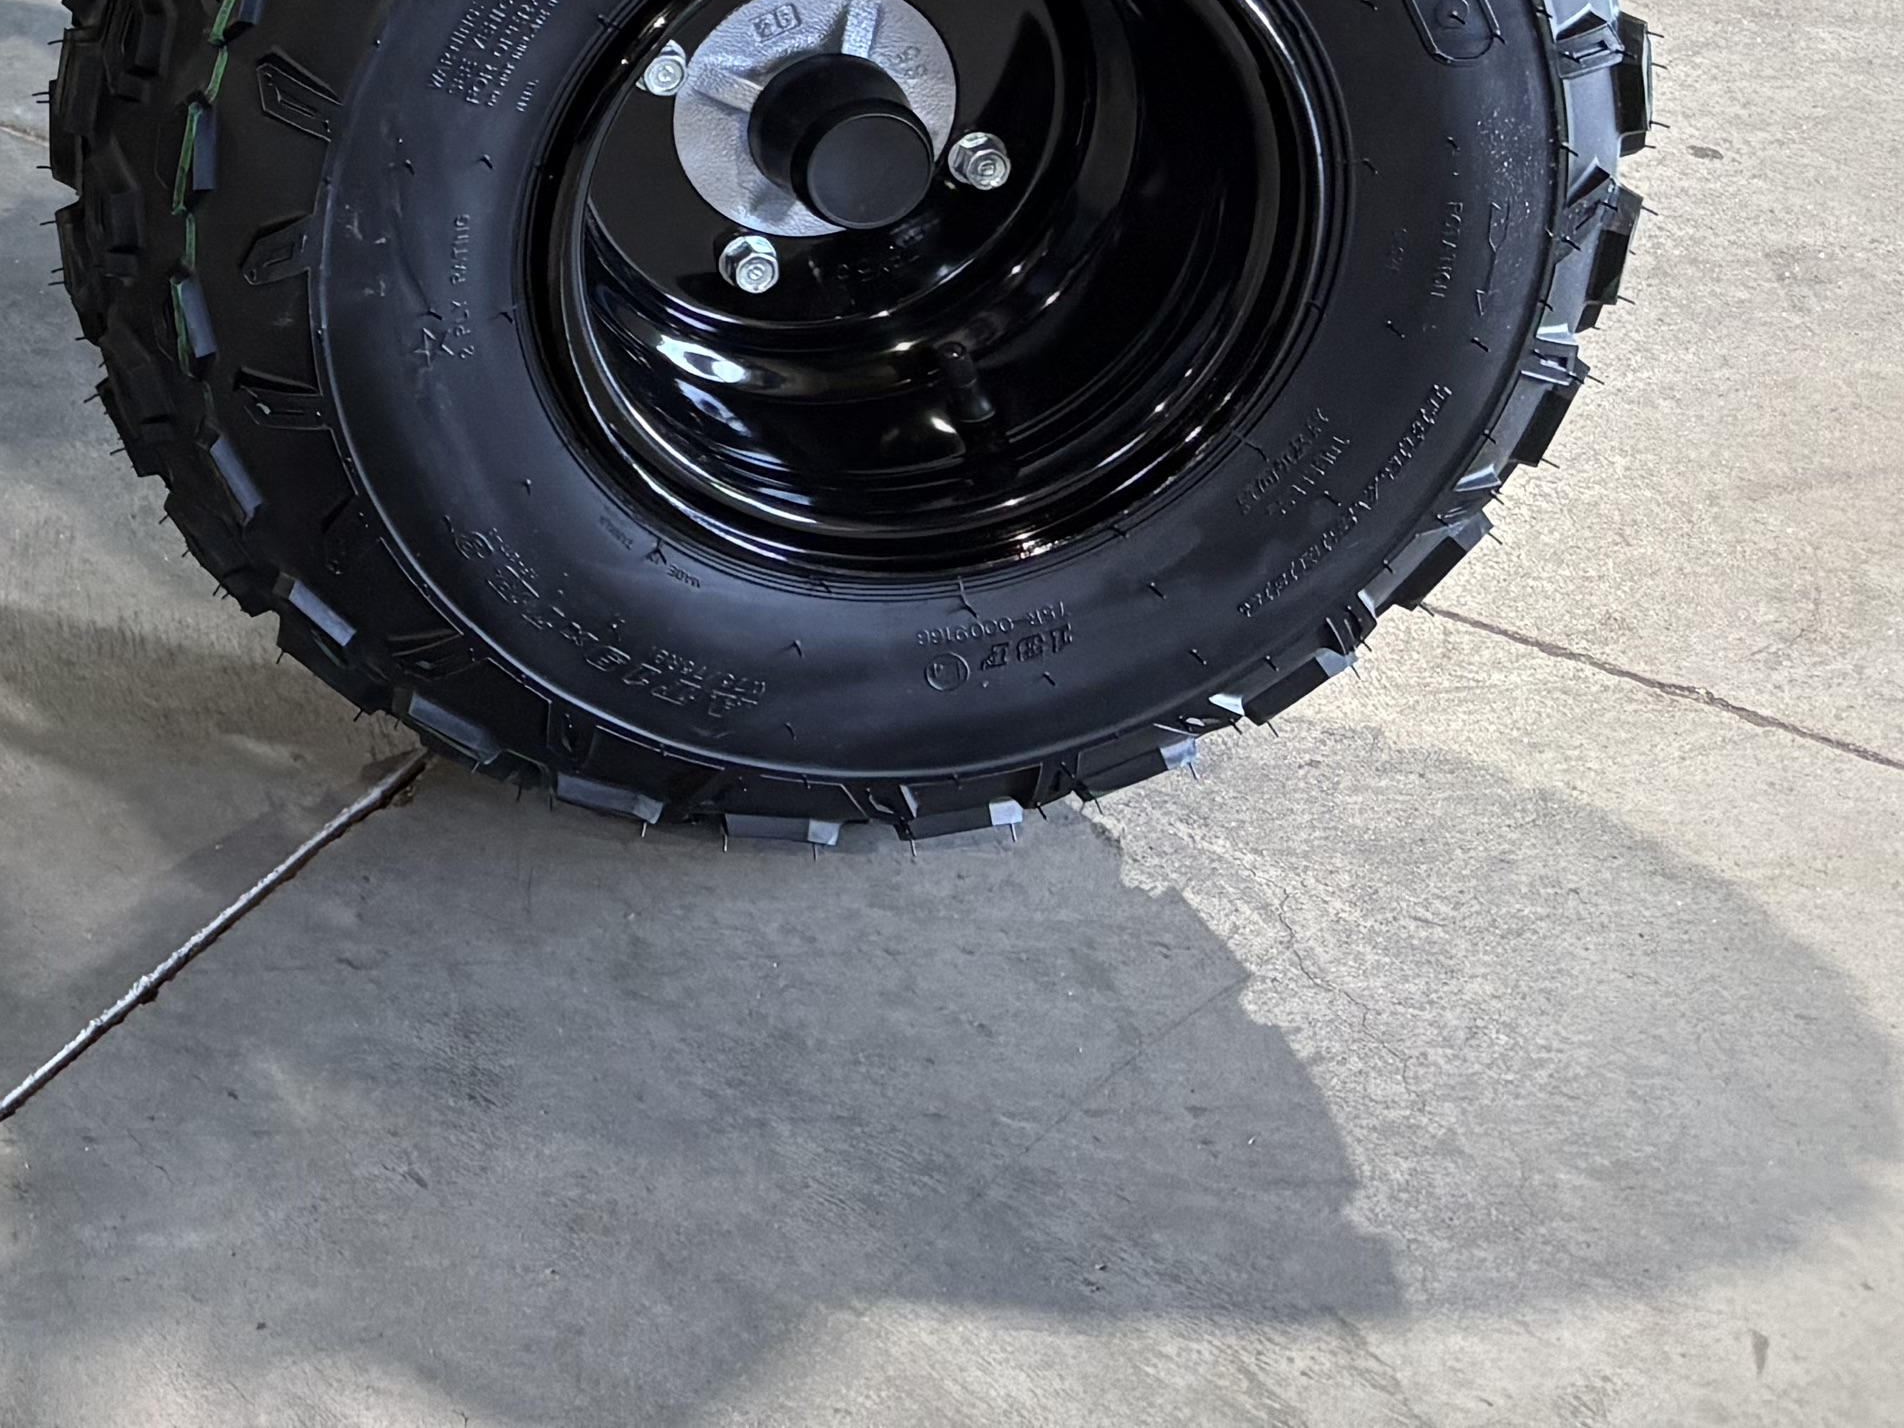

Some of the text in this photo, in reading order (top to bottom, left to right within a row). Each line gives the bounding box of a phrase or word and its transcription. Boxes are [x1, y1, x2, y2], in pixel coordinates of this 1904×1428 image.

[465, 63, 493, 105] FOR
[450, 212, 471, 290] RATING
[453, 296, 476, 342] PLY
[667, 564, 701, 589] MADE
